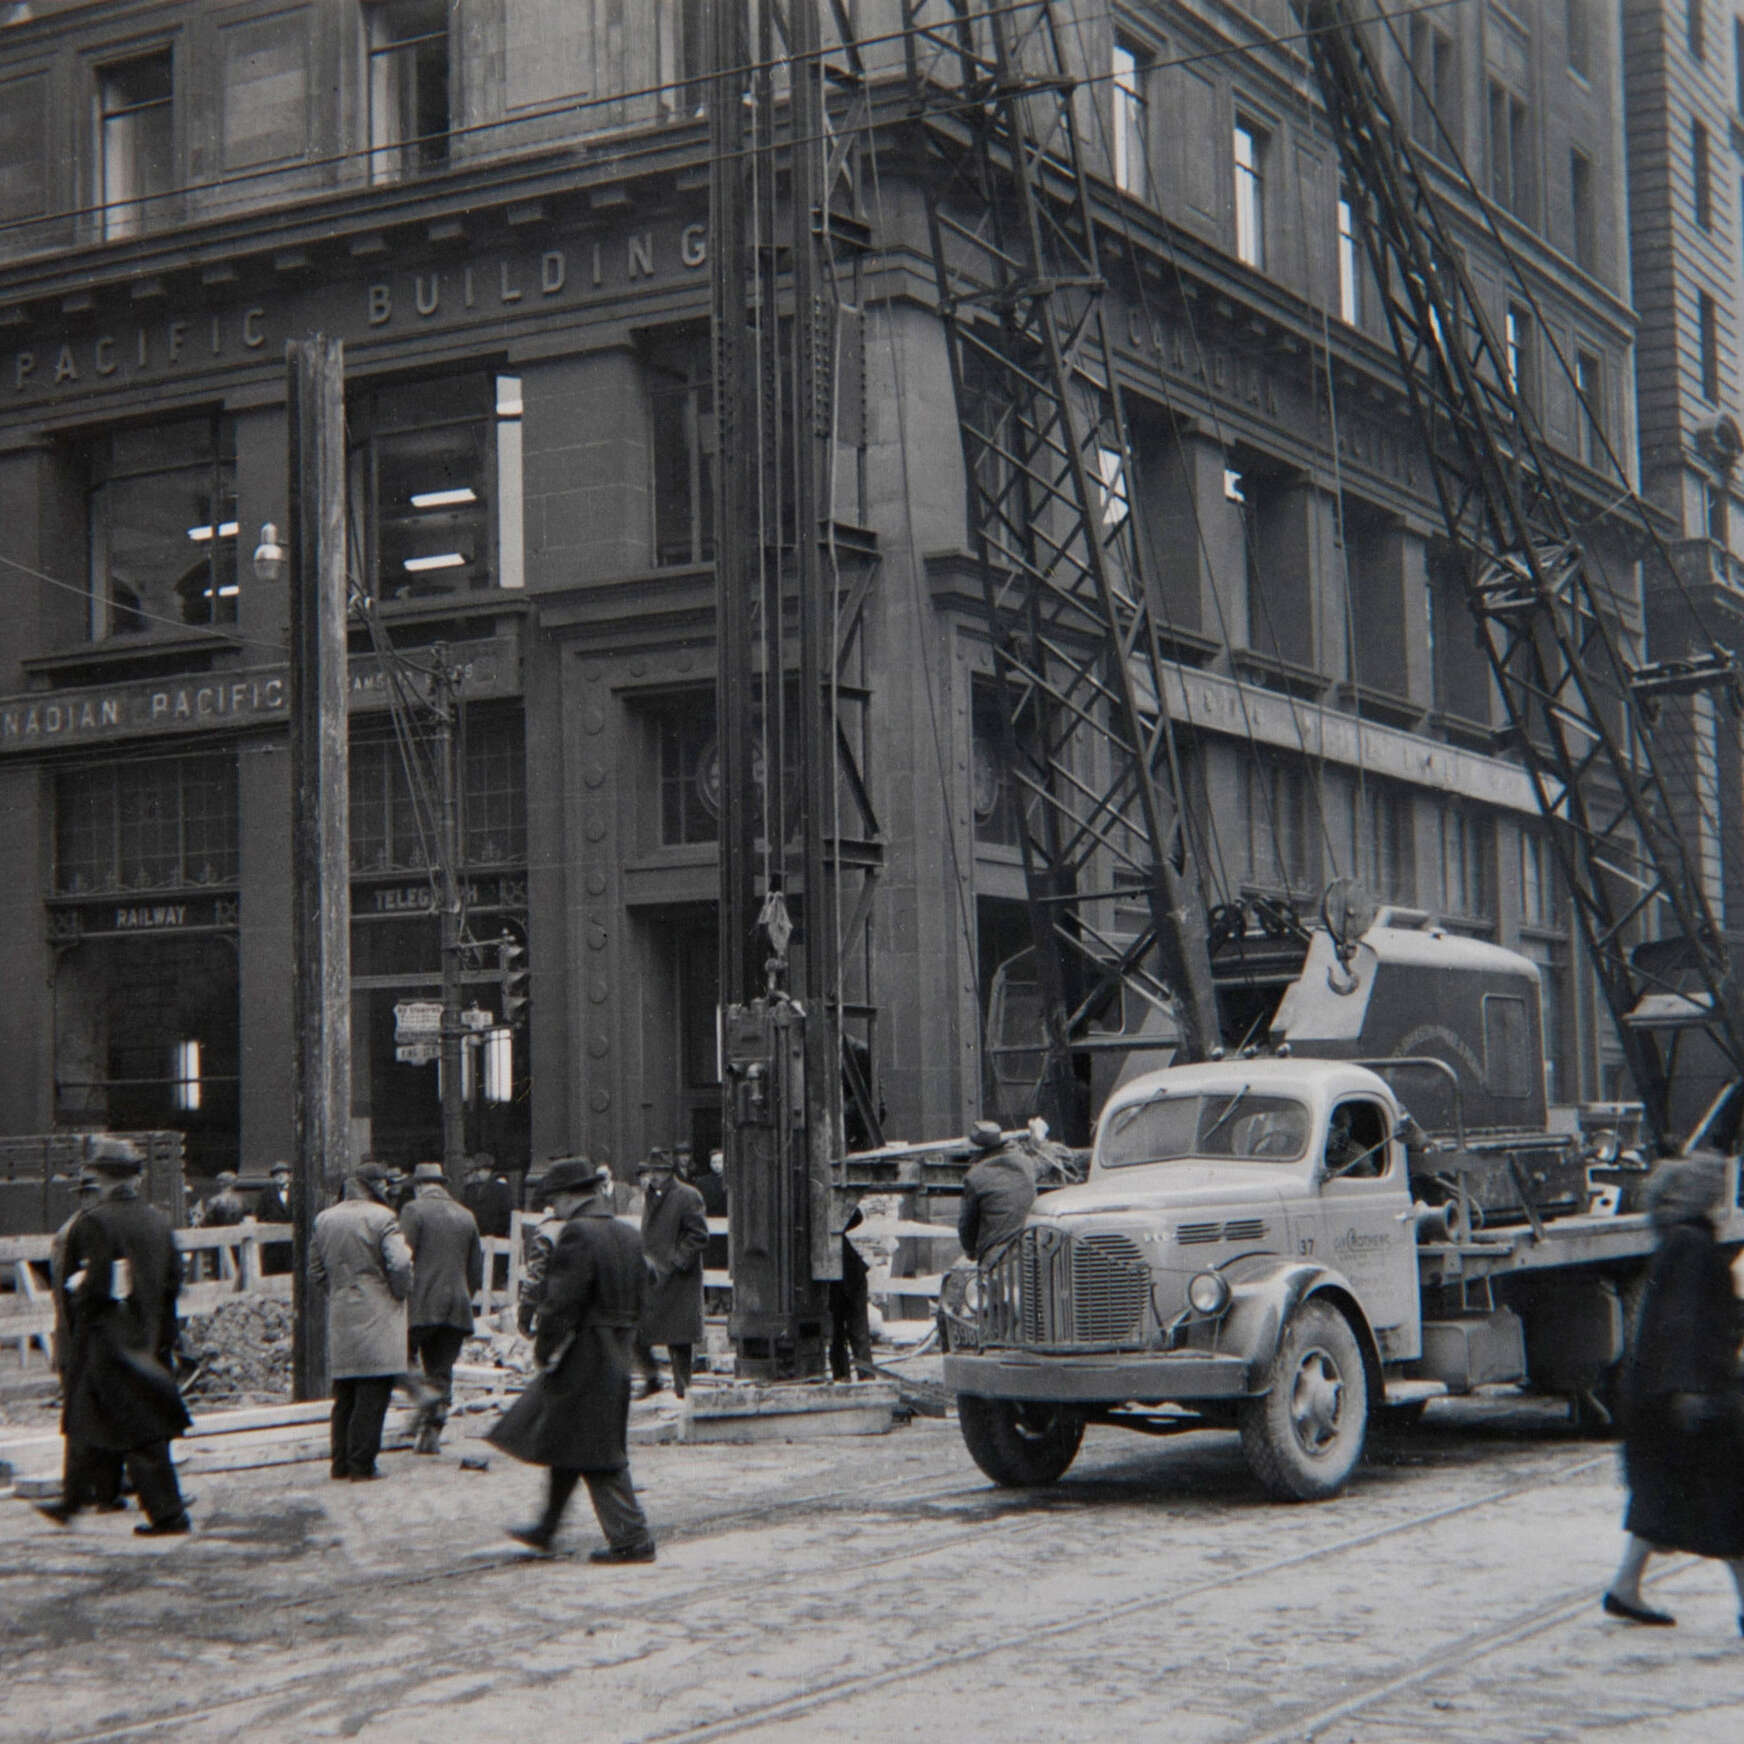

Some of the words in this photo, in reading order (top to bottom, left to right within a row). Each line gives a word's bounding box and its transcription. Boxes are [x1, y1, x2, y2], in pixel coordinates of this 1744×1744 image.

[16, 308, 265, 390] PACIFIC
[368, 224, 707, 325] BUILDING
[152, 679, 284, 721] PACIFIC
[374, 884, 478, 912] TELEGH
[116, 904, 187, 929] RAILWAY
[1300, 1238, 1315, 1257] 37
